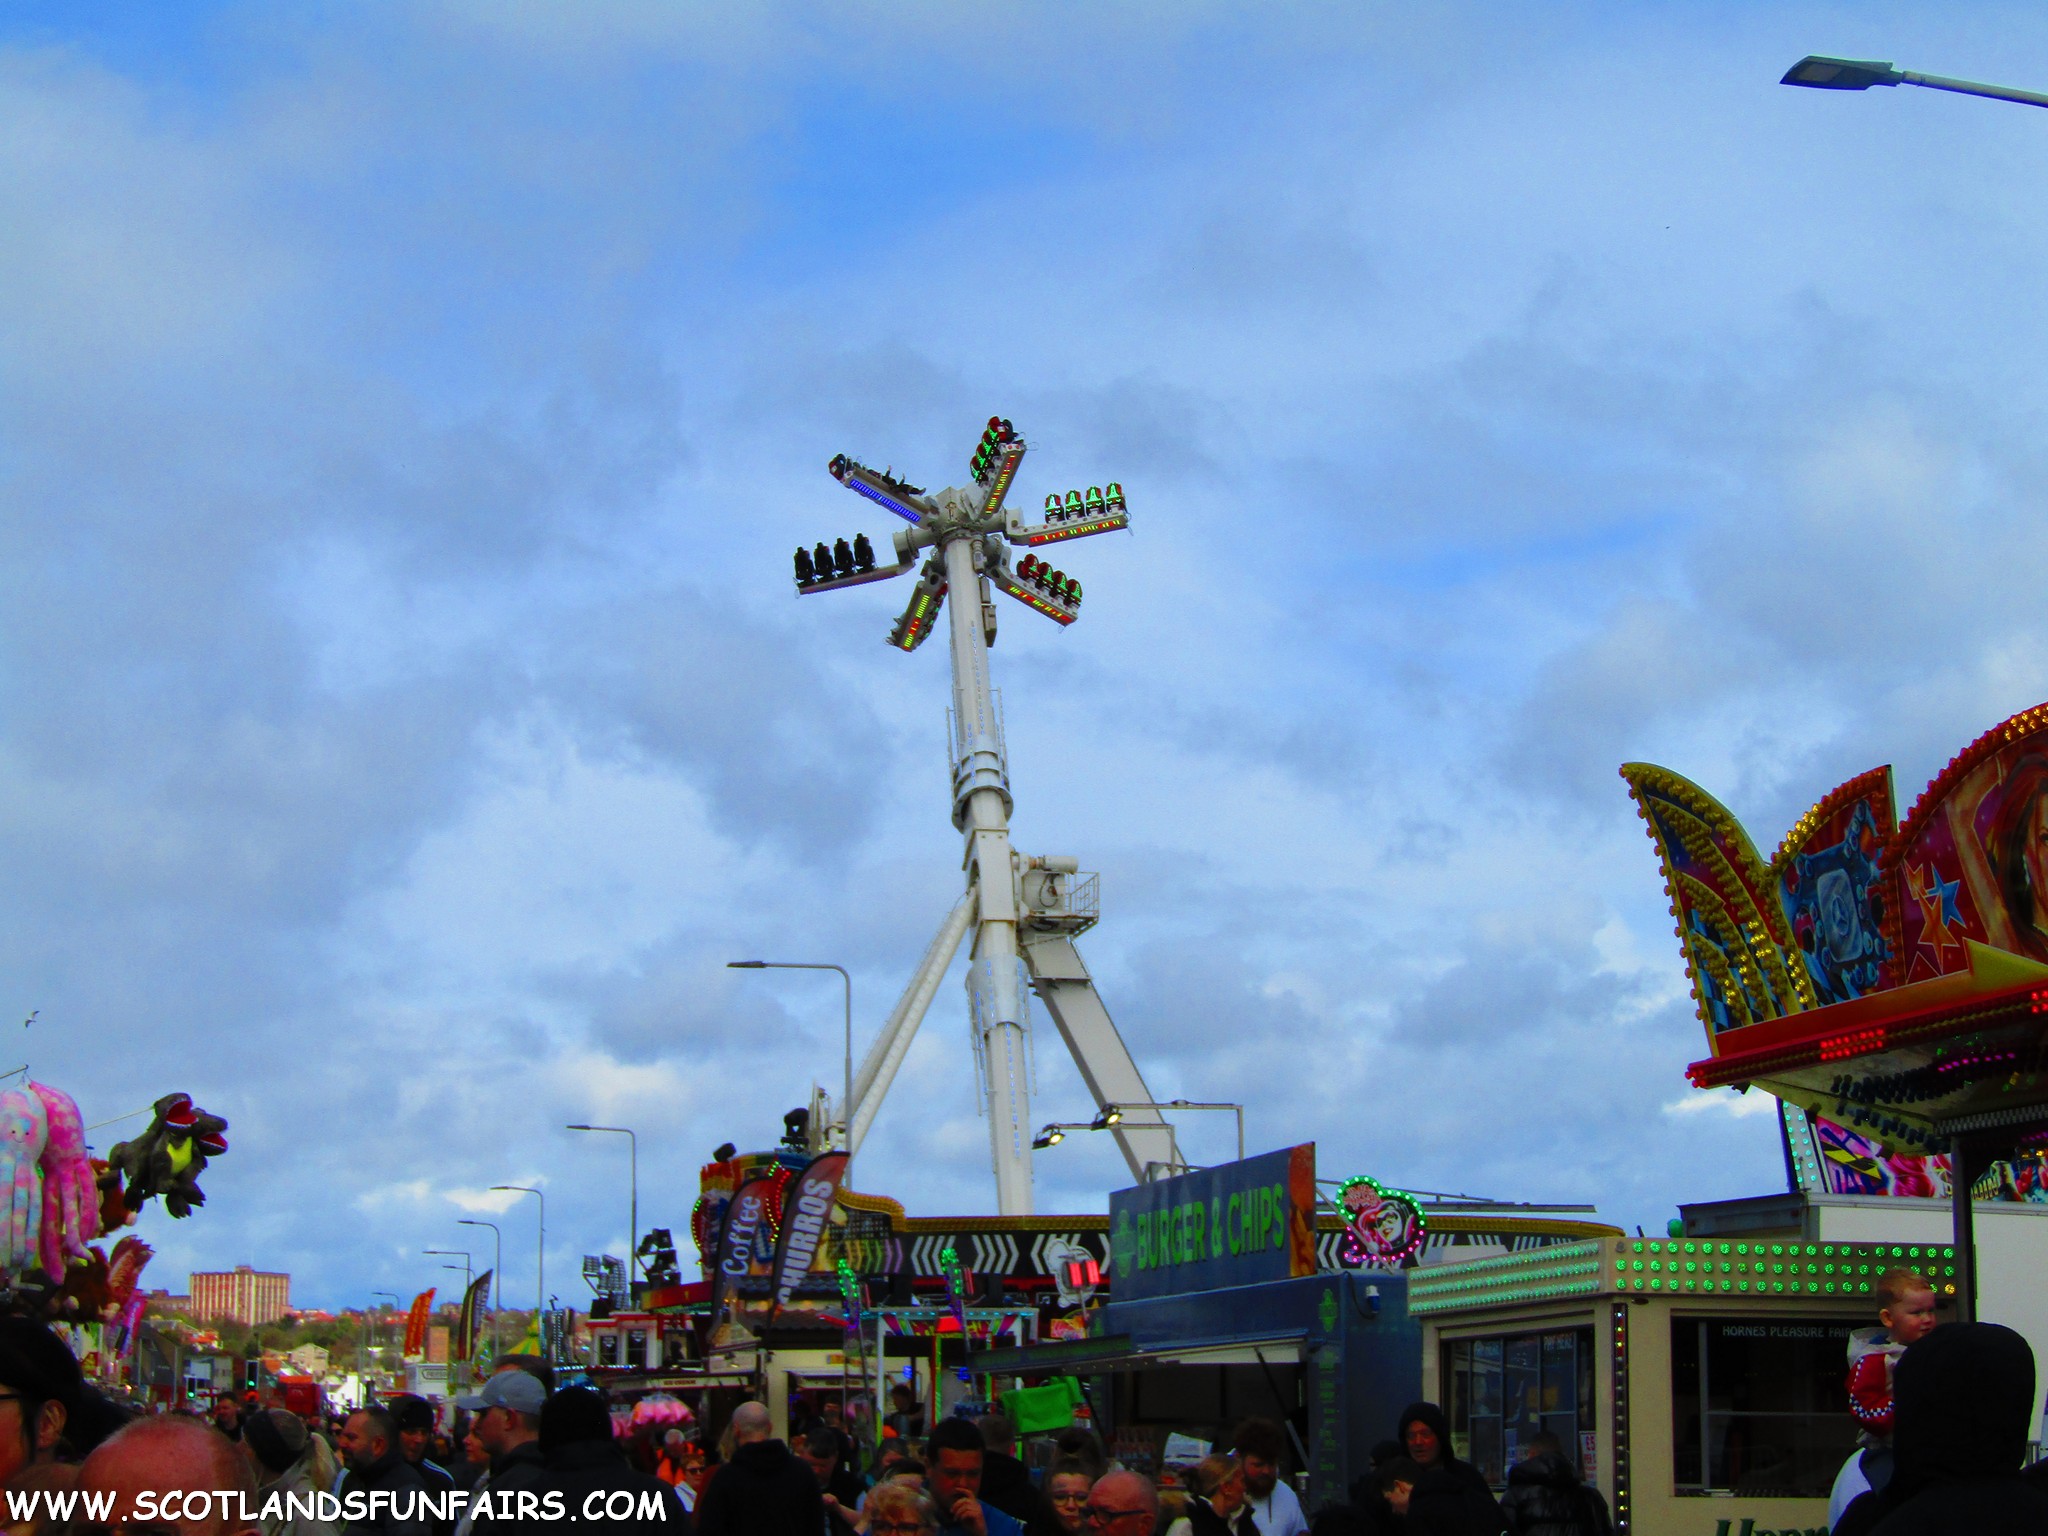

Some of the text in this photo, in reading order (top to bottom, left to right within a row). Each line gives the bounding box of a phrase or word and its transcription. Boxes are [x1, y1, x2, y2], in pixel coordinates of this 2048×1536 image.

[722, 1196, 761, 1276] Coffee
[1137, 1183, 1285, 1269] BURGER & CHIPS
[1722, 1325, 1767, 1337] HORNES
[1769, 1326, 1825, 1338] PLEASURE
